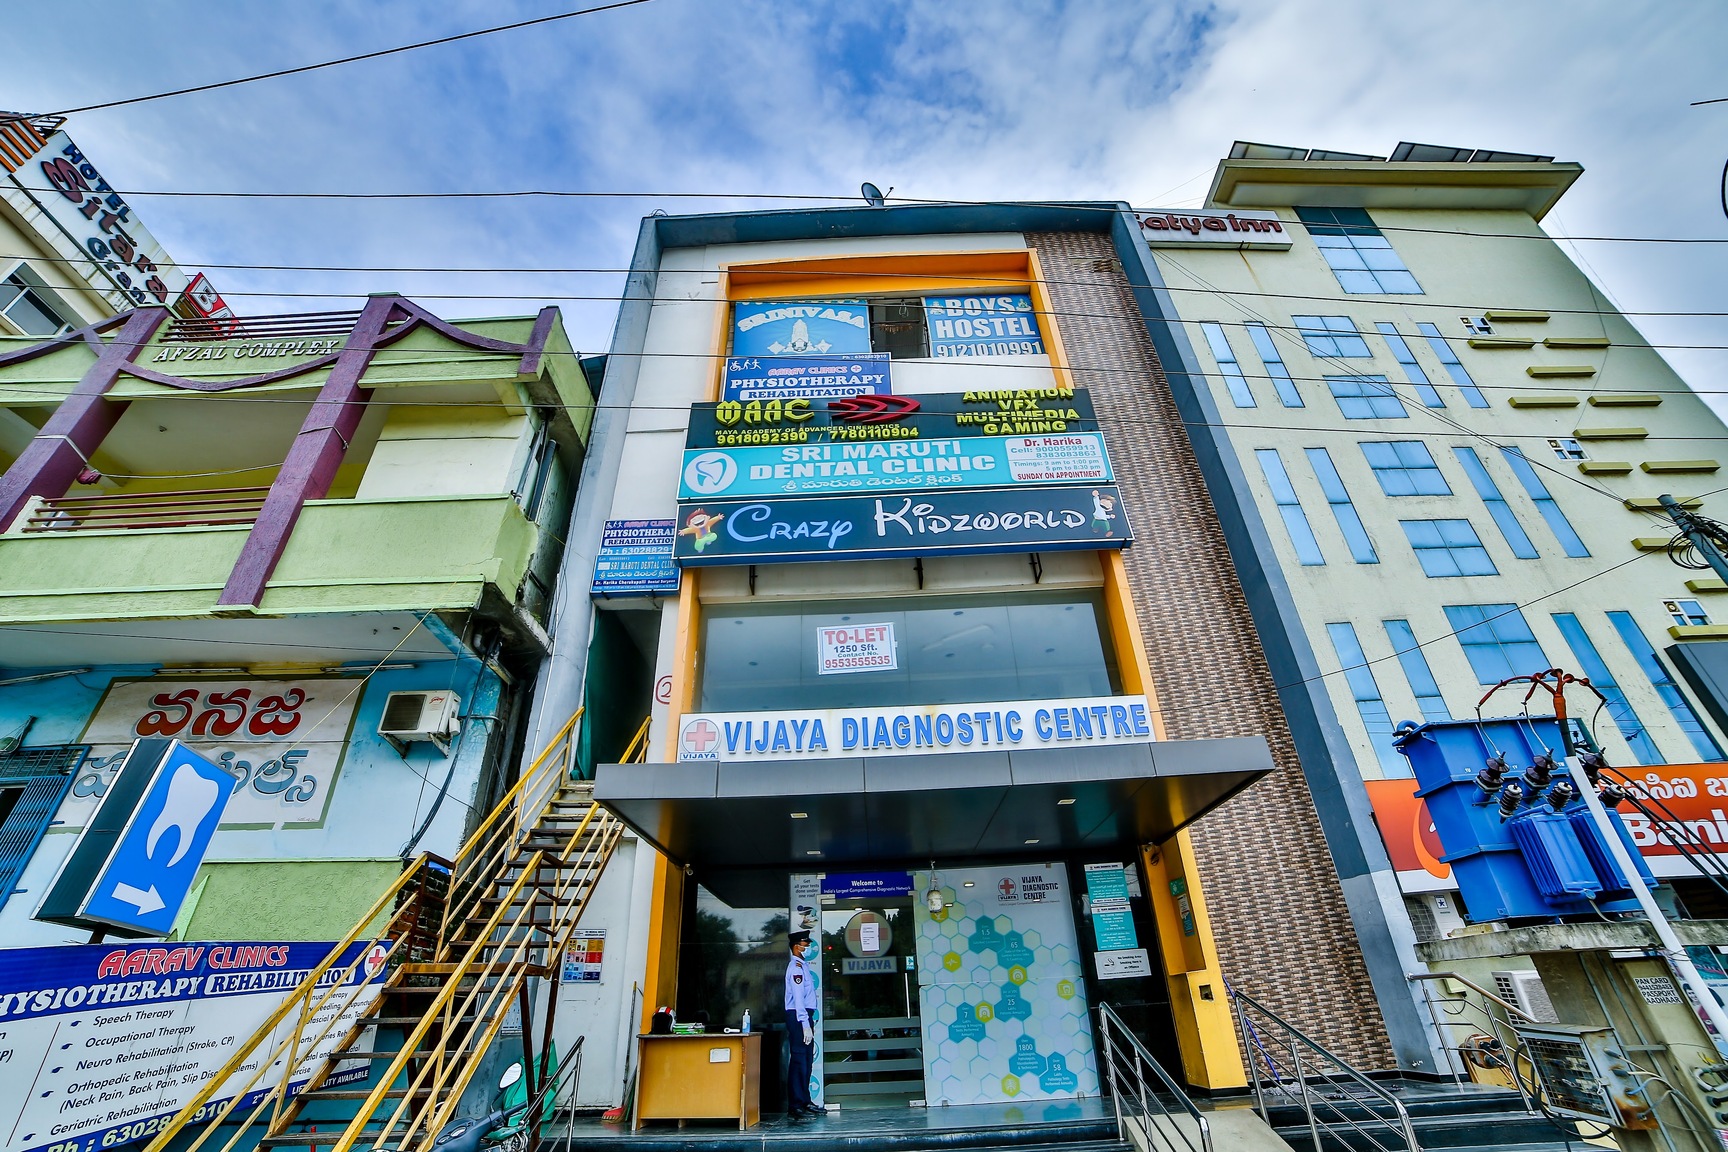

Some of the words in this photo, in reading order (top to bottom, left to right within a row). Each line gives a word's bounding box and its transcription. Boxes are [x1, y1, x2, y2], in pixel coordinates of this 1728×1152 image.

[62, 144, 130, 223] HOTEL
[41, 157, 168, 303] Sitara
[87, 237, 147, 304] Gran
[945, 297, 1016, 317] BOYS
[737, 307, 866, 333] SRINIVASA
[935, 317, 1036, 339] HOSTEL
[153, 345, 227, 362] AFZAL
[234, 340, 339, 359] COMPLEX
[936, 341, 1043, 358] 9121010991
[768, 367, 806, 376] AARAV
[808, 366, 848, 375] CLINICS
[730, 374, 885, 389] PHYSIOTHERAPY
[748, 388, 866, 399] REHABILITATION
[962, 388, 1074, 402] ANIMATION
[715, 398, 815, 427] MAAC
[998, 399, 1039, 412] VFX
[956, 408, 1080, 424] MULTIMEDIA
[716, 431, 808, 445] 9618092390
[829, 427, 919, 441] 7780110904
[983, 420, 1067, 436] GAMING
[781, 446, 831, 462] SRI
[843, 440, 961, 459] MARUTI
[1024, 439, 1040, 447] Dr.
[1043, 437, 1082, 446] Harika
[750, 460, 874, 480] DENTAL
[882, 455, 996, 473] CLINIC
[1056, 470, 1101, 478] APPOINTMENT
[824, 627, 887, 645] TO-LET
[834, 645, 858, 653] 1250
[861, 643, 878, 652] Sft.
[825, 655, 891, 669] 9553555535
[724, 718, 828, 755] VIJAYA
[842, 709, 1023, 751] DIAGNOSTIC
[1034, 704, 1150, 742] CENTRE
[1022, 876, 1043, 884] VIJAYA
[1023, 883, 1059, 892] DIAGNOSTIC
[1024, 891, 1046, 900] CENTRE
[1010, 941, 1018, 949] 65
[98, 947, 205, 979] AARAV
[208, 945, 289, 970] CLINICS
[848, 960, 892, 971] VIJAYA
[1646, 996, 1681, 1004] AADHAAR
[93, 1013, 131, 1030] Speech
[135, 1008, 175, 1022] Therapy
[85, 1027, 156, 1048] Occupational
[158, 1024, 196, 1036] Therapy
[75, 1057, 113, 1071] Neuro
[115, 1044, 184, 1064] Rehabilitation
[185, 1039, 218, 1054] (Stroke,
[221, 1035, 235, 1047] CP)
[67, 1072, 131, 1095] Orthopedic
[133, 1061, 199, 1081] Rehabilitation
[338, 1069, 369, 1085] AVAILABLE
[59, 1094, 96, 1114] (Neck
[98, 1089, 125, 1103] Pain,
[128, 1082, 153, 1096] Back
[155, 1078, 179, 1090] Pain,
[181, 1073, 199, 1088] Slip
[50, 1114, 104, 1136] Geriatric
[105, 1097, 178, 1122] Rehabilitation
